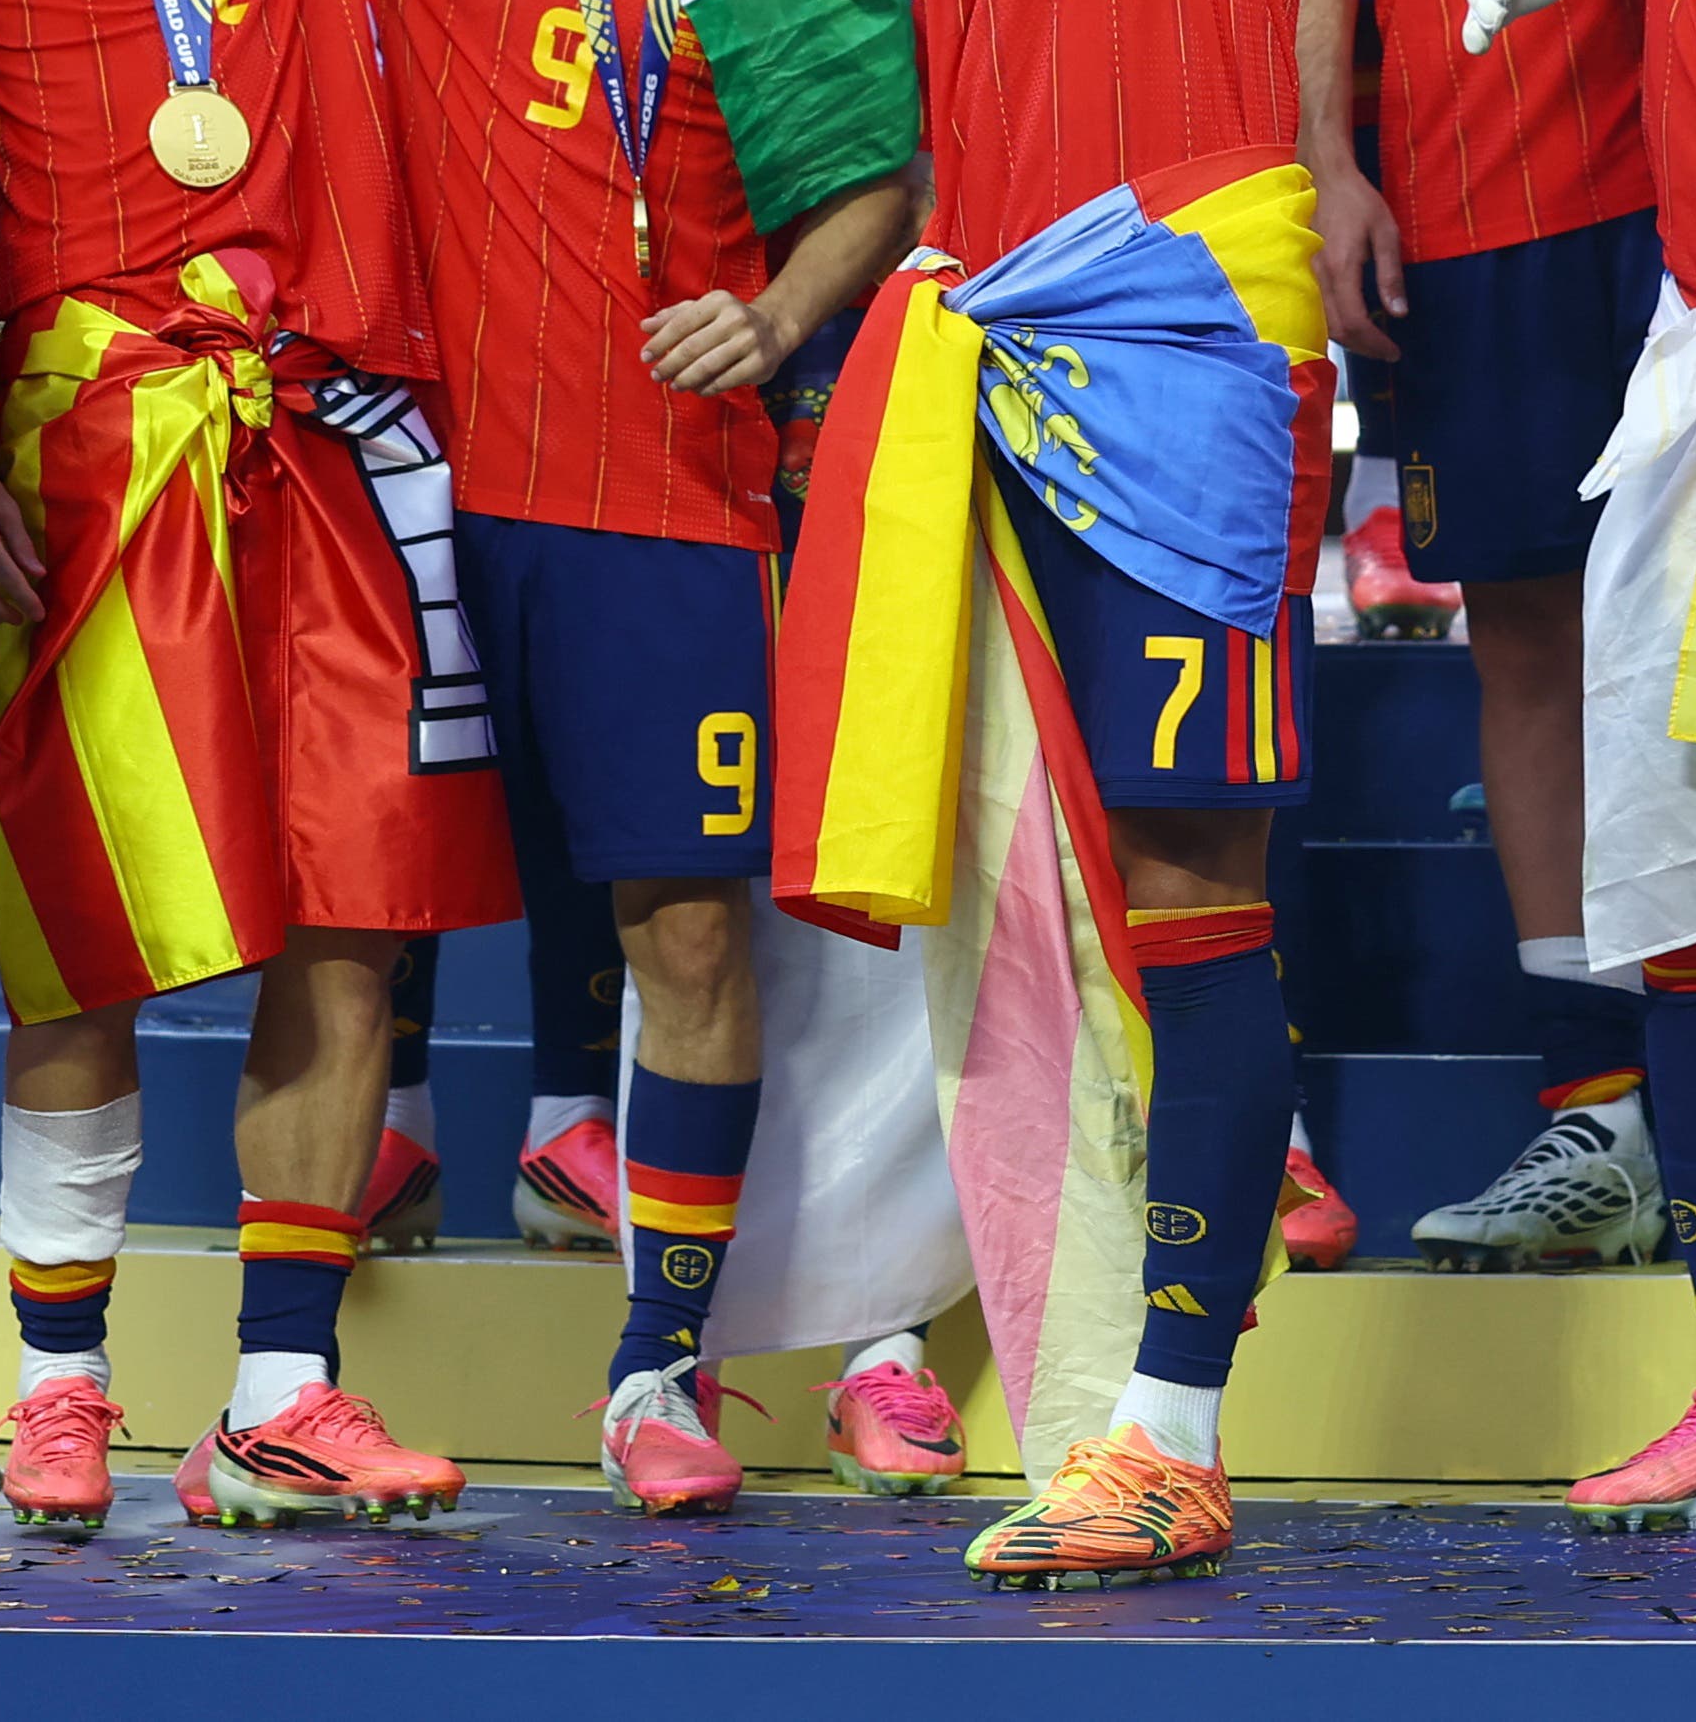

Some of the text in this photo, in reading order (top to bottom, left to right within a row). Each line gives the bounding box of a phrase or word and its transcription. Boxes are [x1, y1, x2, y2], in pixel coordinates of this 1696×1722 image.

[174, 33, 195, 69] CUP
[525, 7, 597, 129] 9
[608, 78, 624, 118] FIFA
[641, 74, 658, 140] 2026
[1144, 636, 1205, 770] 7
[697, 712, 756, 836] 9
